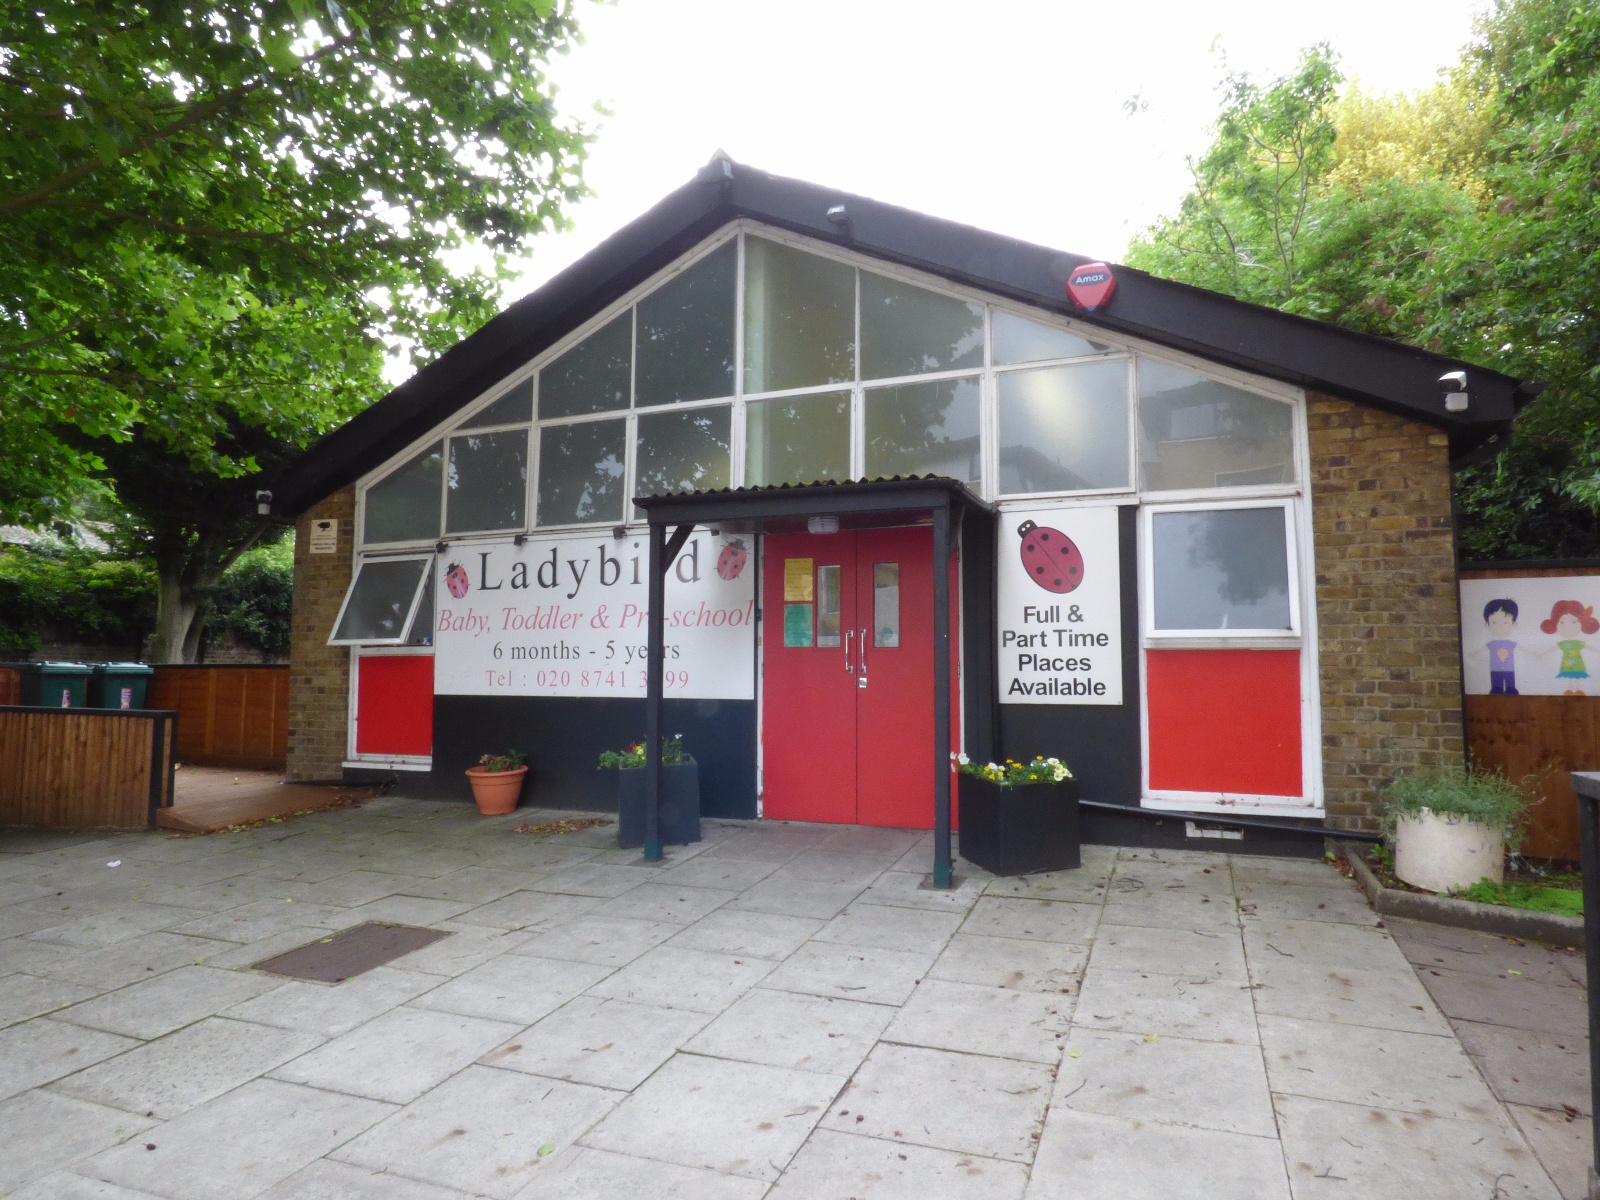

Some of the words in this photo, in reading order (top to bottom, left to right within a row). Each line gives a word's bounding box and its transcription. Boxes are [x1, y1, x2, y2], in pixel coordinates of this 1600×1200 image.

[1075, 274, 1104, 285] Amax
[477, 539, 702, 600] Ladybid
[437, 607, 491, 637] Baby,
[501, 605, 583, 630] Toddler
[590, 604, 610, 629] &
[618, 599, 754, 629] Pr-school
[1023, 605, 1060, 624] Full
[1067, 605, 1084, 623] &
[1002, 630, 1048, 648] Part
[1053, 629, 1109, 647] Time
[493, 641, 503, 660] 6
[511, 640, 580, 660] months
[605, 640, 615, 660] 5
[624, 644, 680, 665] yers
[1018, 653, 1092, 671] Places
[486, 670, 512, 687] Tel
[536, 670, 571, 687] 020
[580, 670, 626, 688] 8741
[639, 670, 689, 689] 399
[1008, 678, 1107, 696] Available
